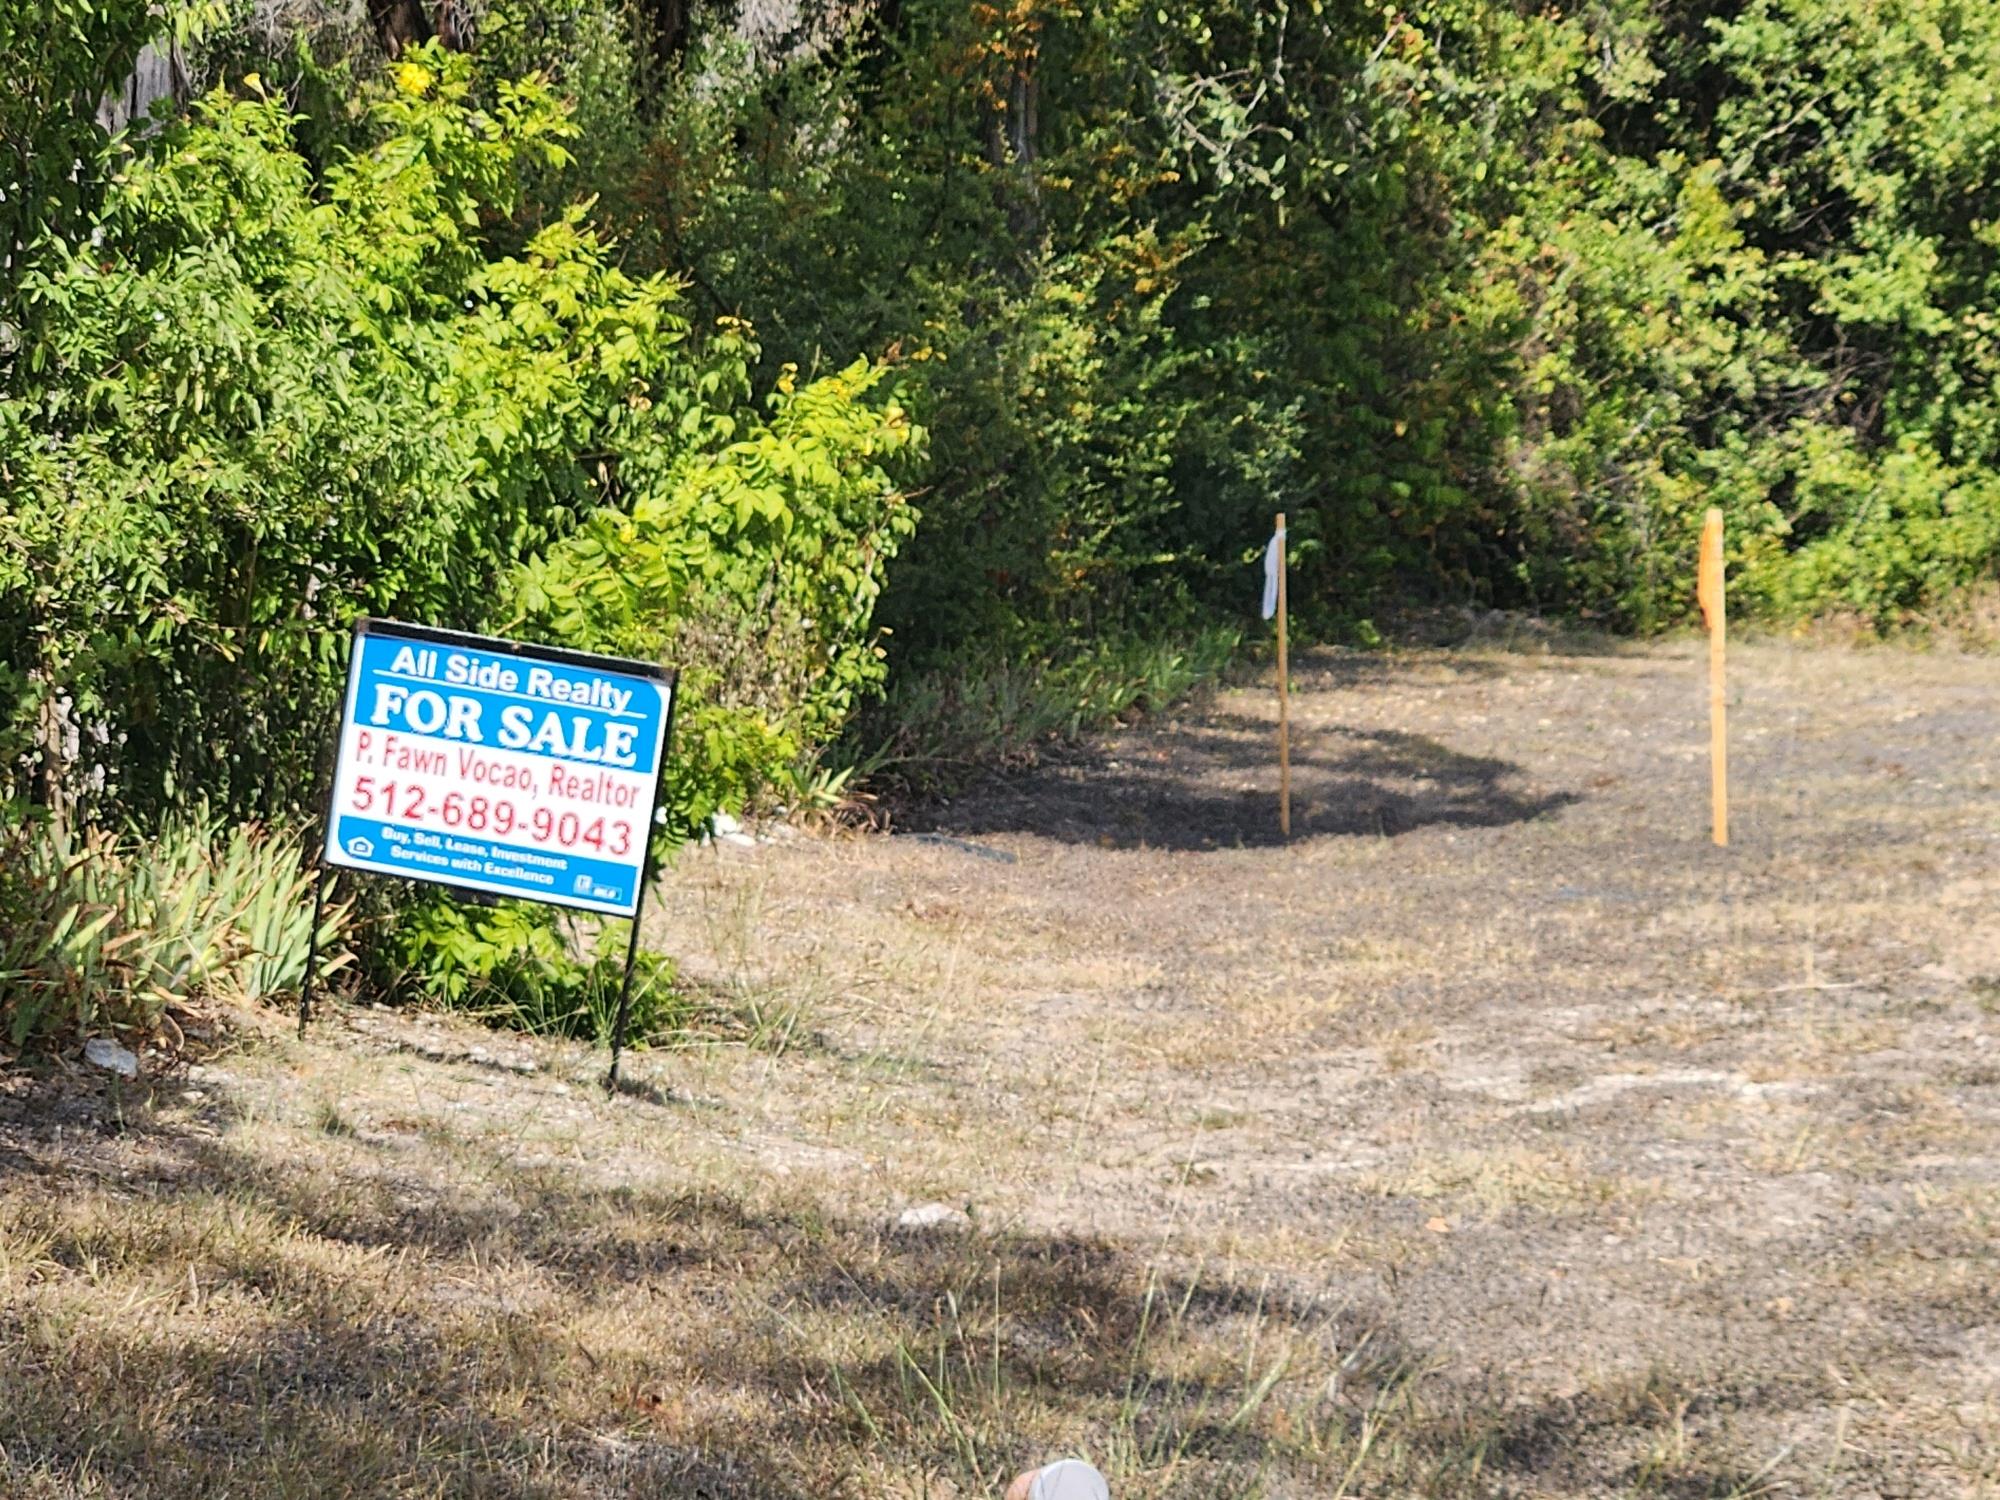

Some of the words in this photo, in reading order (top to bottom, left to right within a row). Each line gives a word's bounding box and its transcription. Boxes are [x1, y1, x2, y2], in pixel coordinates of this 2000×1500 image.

[390, 646, 436, 678] All
[446, 655, 518, 692] Side
[528, 668, 632, 712] Realty
[371, 684, 484, 742] FOR
[498, 706, 639, 767] SALE
[356, 731, 373, 765] P.
[382, 738, 447, 776] Fawn
[459, 748, 539, 799] Vocao,
[549, 765, 640, 809] Realtor
[352, 776, 631, 856] 512-689-9043
[381, 828, 411, 847] Buy,
[414, 832, 441, 851] Sell,
[446, 836, 488, 858] Lease,
[491, 844, 568, 870] Investment
[391, 845, 448, 867] Services
[451, 854, 481, 871] with
[484, 862, 554, 885] Excellence
